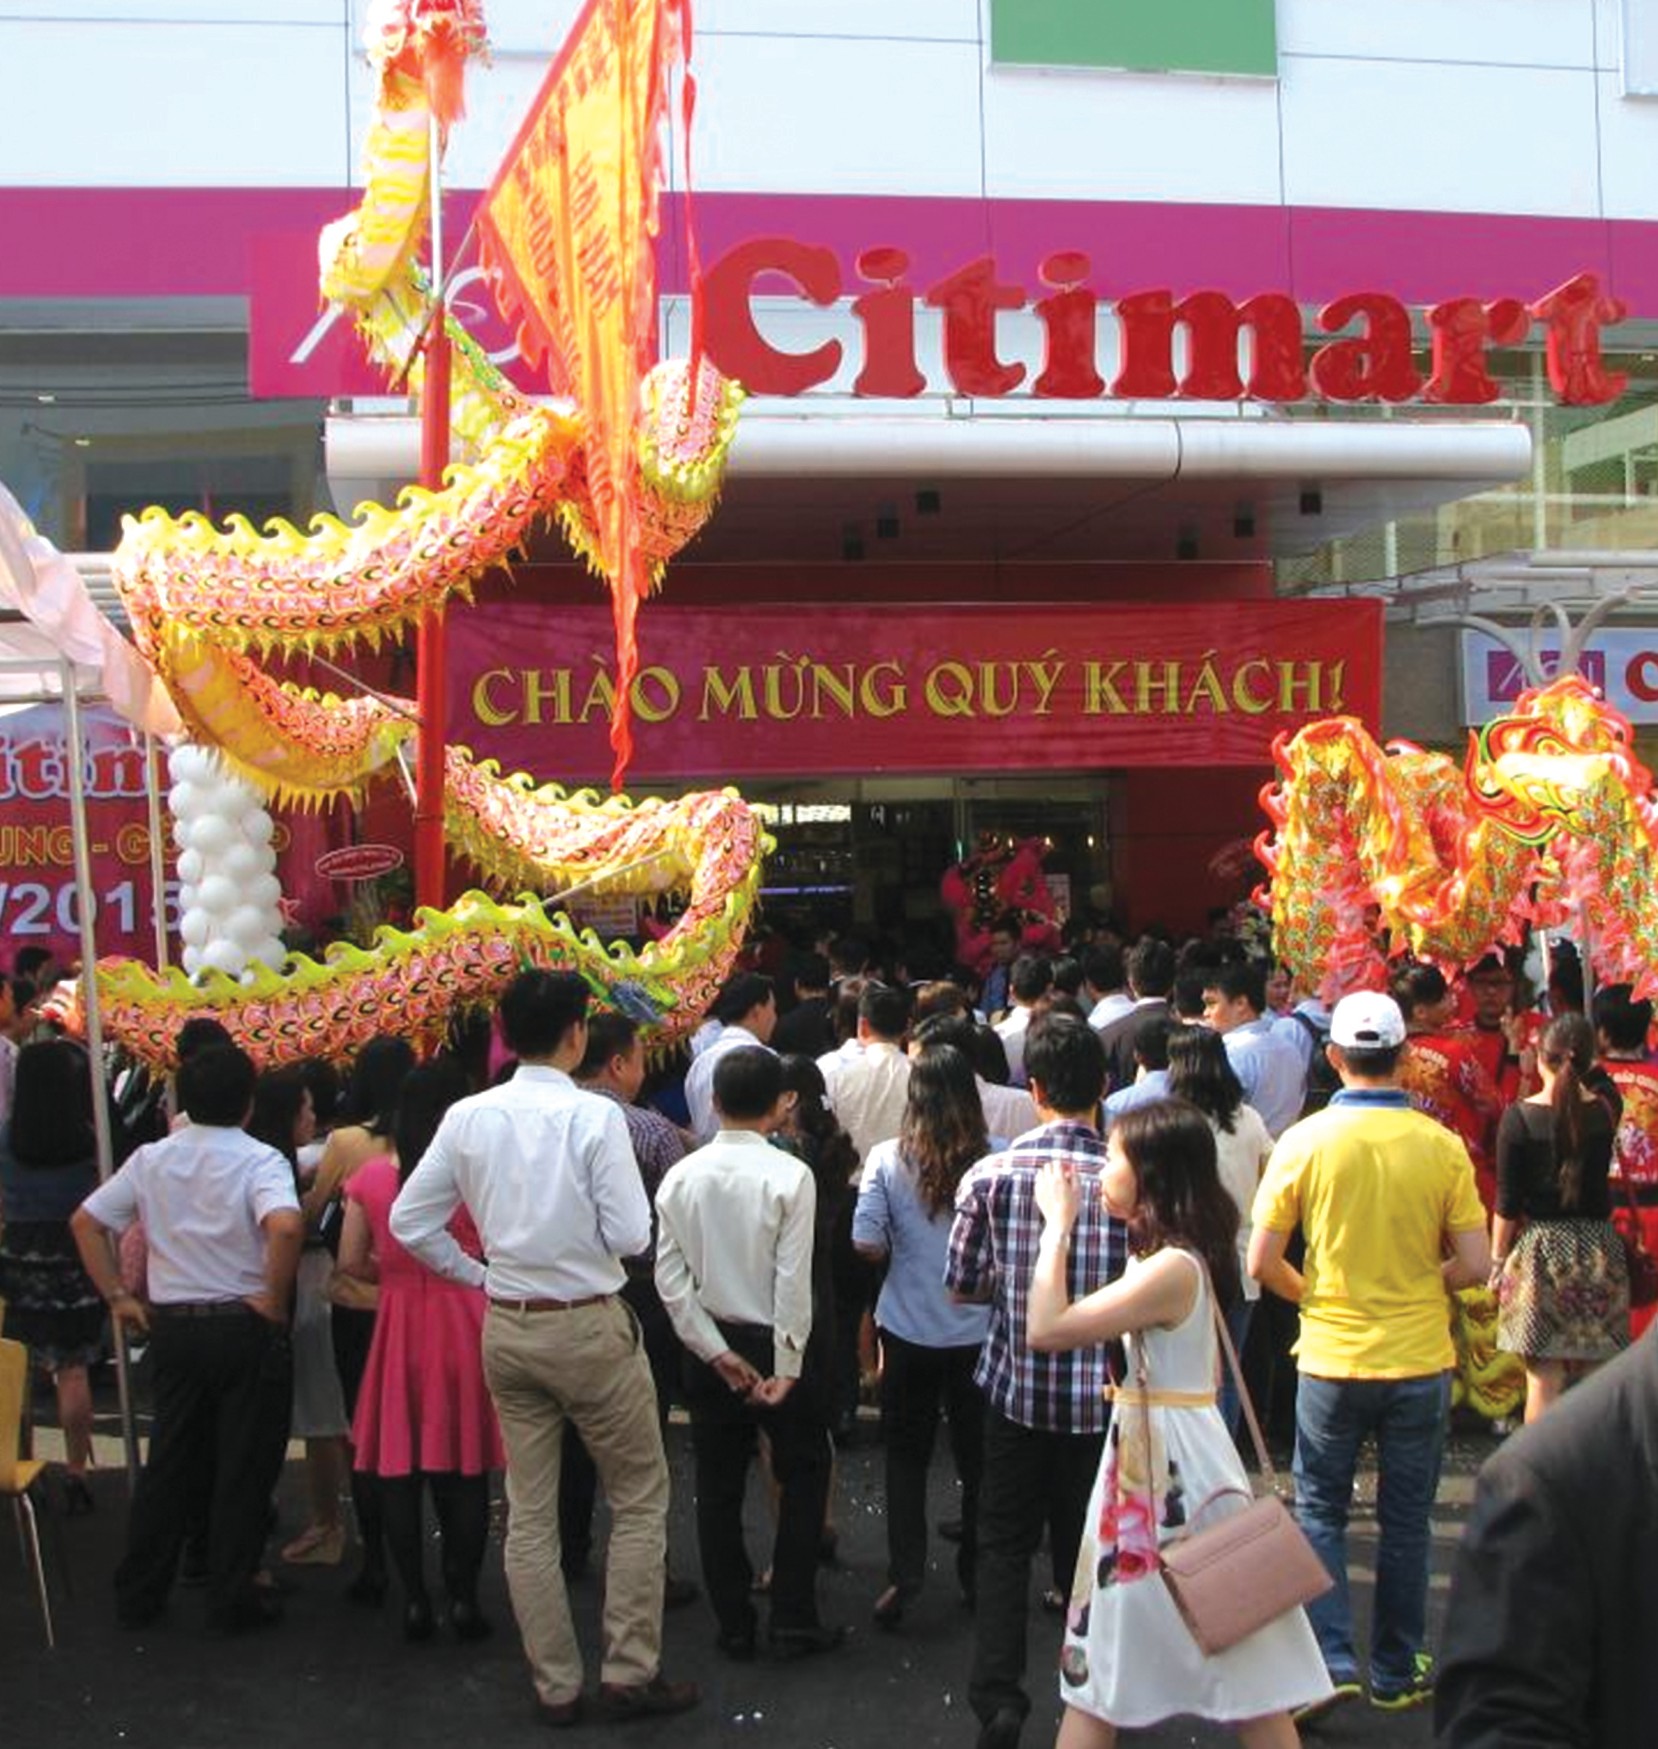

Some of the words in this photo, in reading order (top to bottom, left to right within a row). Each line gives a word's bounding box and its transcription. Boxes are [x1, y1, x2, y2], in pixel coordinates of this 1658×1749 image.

[701, 237, 1628, 406] Citimart
[472, 654, 680, 725] CHÀO
[698, 650, 907, 721] MỪNG
[925, 649, 1066, 717] QUÝ
[1083, 649, 1347, 715] KHÁCH!
